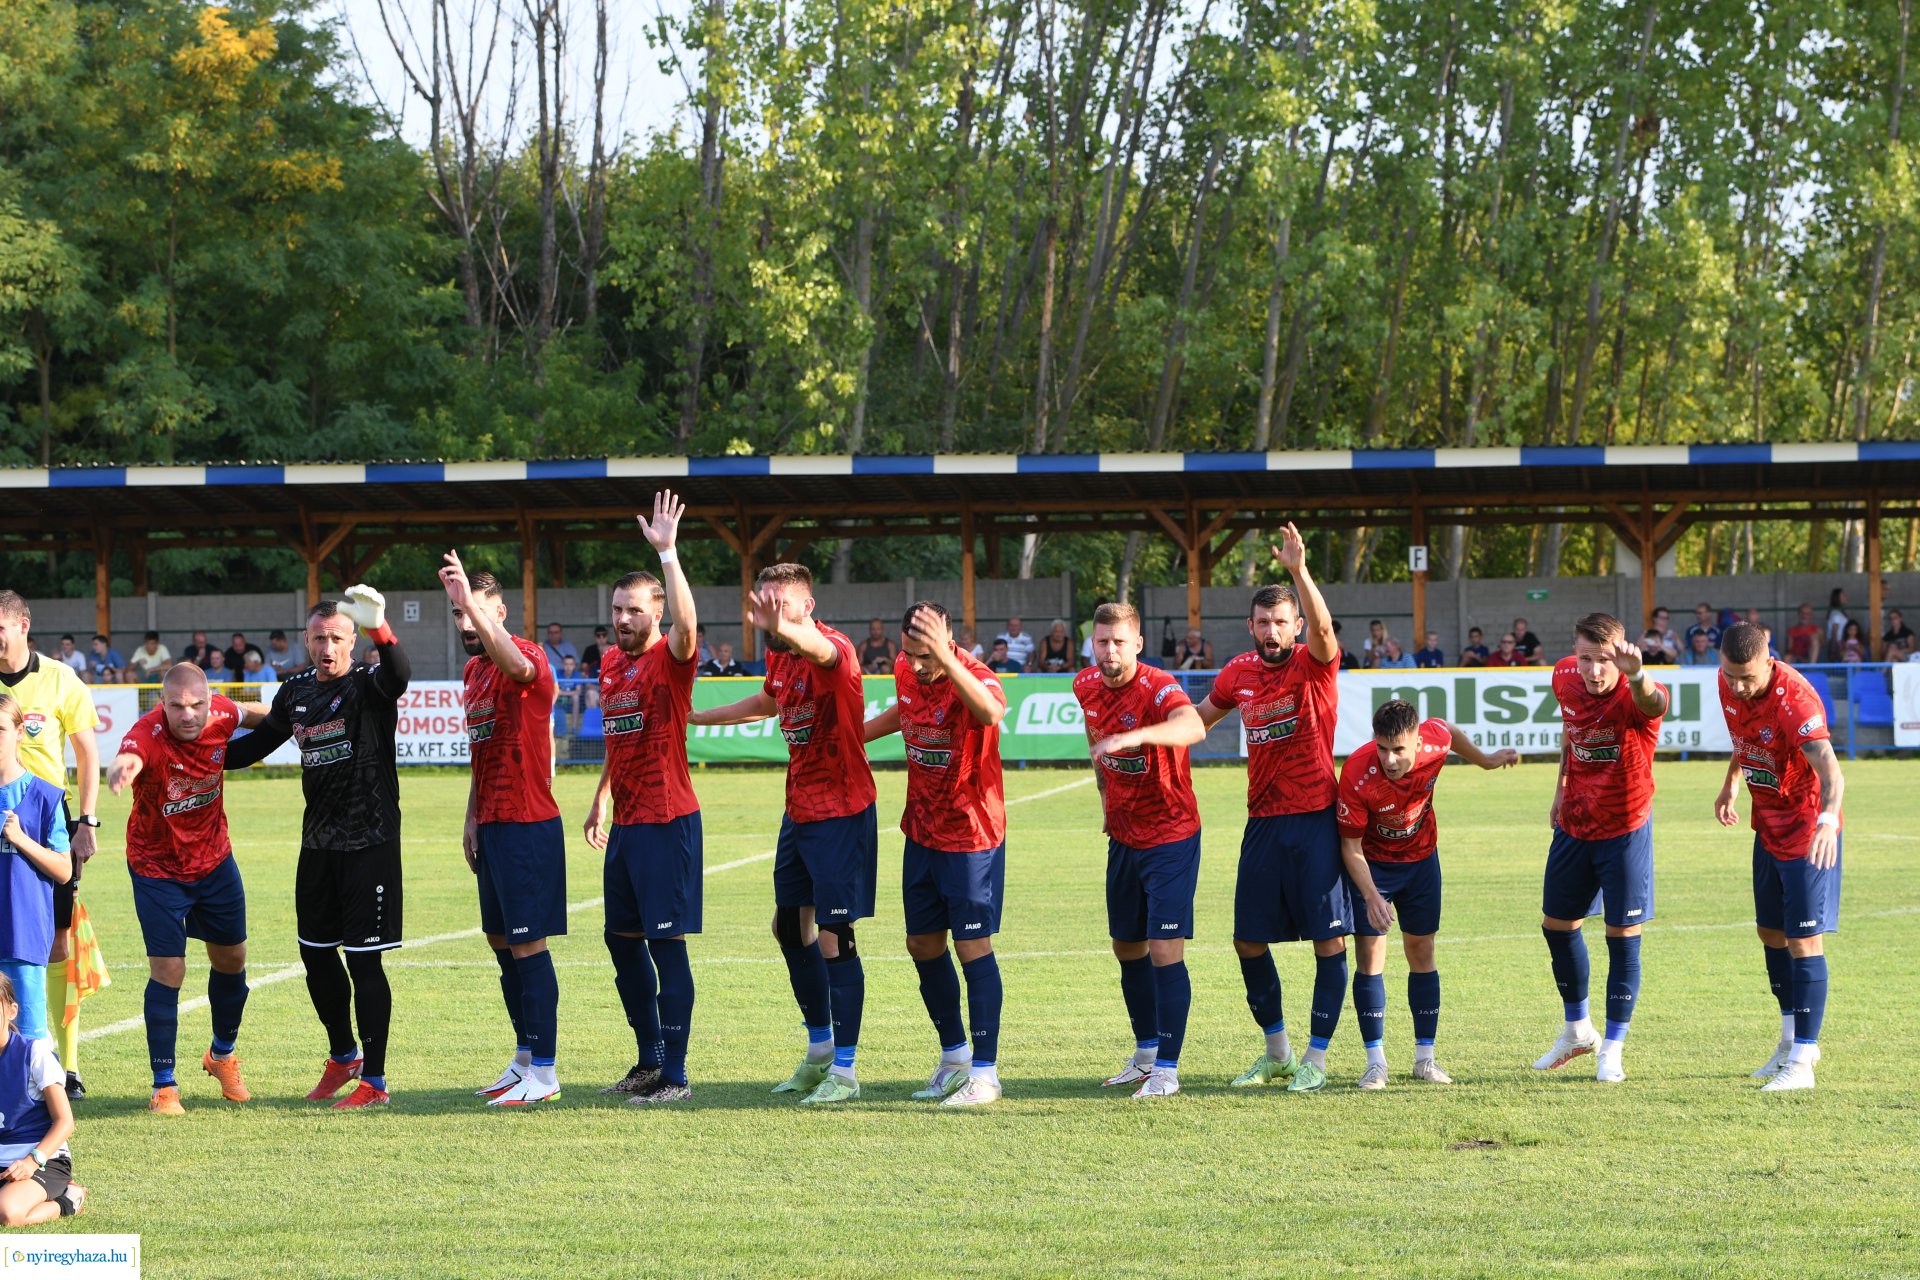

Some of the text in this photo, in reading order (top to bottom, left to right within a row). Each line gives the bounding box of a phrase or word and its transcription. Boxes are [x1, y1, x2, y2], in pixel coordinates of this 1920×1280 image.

[1414, 548, 1423, 569] F
[397, 690, 466, 708] SZERV
[397, 710, 468, 735] ÓMOS
[603, 714, 642, 732] PPMIX
[1464, 728, 1562, 748] abdarúg
[303, 743, 349, 765] PPMIX
[396, 742, 413, 757] EX
[418, 742, 446, 757] KFT.
[1379, 803, 1396, 813] JAKO
[1627, 909, 1642, 917] JAKO
[658, 921, 673, 930] JAKO
[964, 922, 982, 930] JAKO
[1161, 923, 1179, 931] JAKO
[1799, 920, 1817, 928] JAKO
[512, 926, 529, 935] JAKO
[364, 936, 380, 944] JAKO
